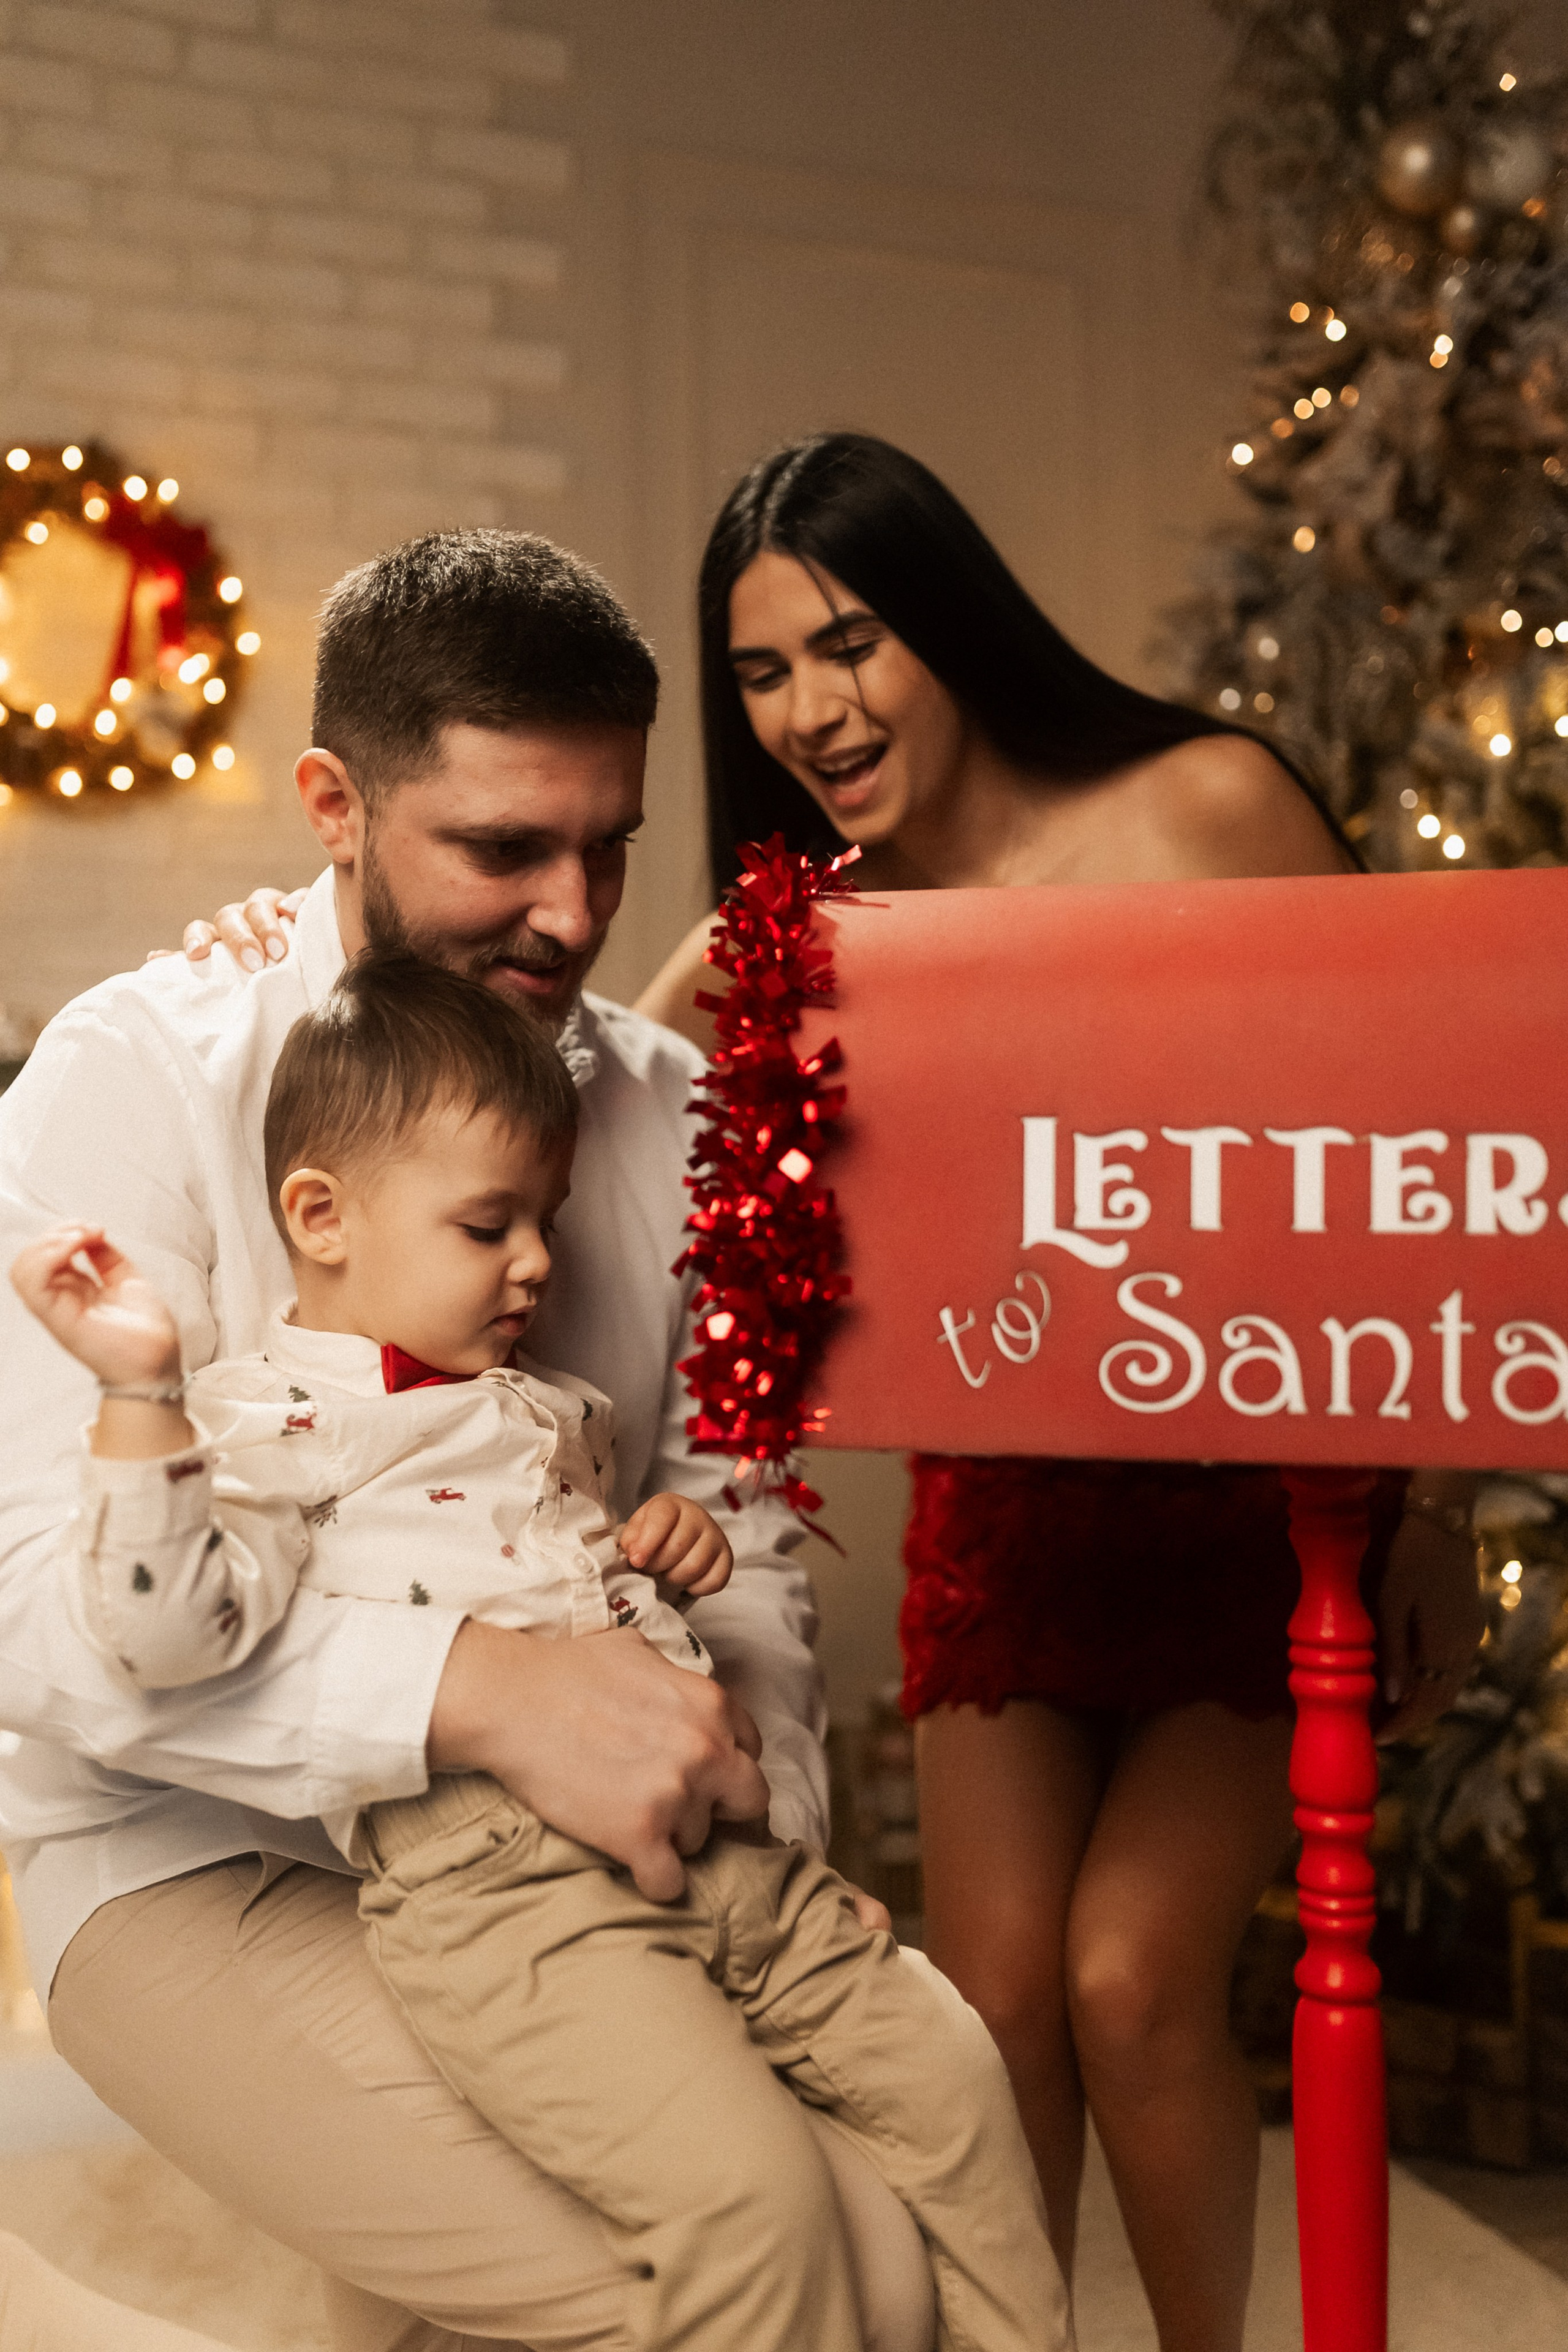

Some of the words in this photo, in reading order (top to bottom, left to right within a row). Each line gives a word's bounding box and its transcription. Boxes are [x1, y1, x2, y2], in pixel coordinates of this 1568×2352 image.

[1020, 1116, 1568, 1268] LETTER
[937, 1270, 1052, 1389] to
[1098, 1272, 1568, 1425] Santa
